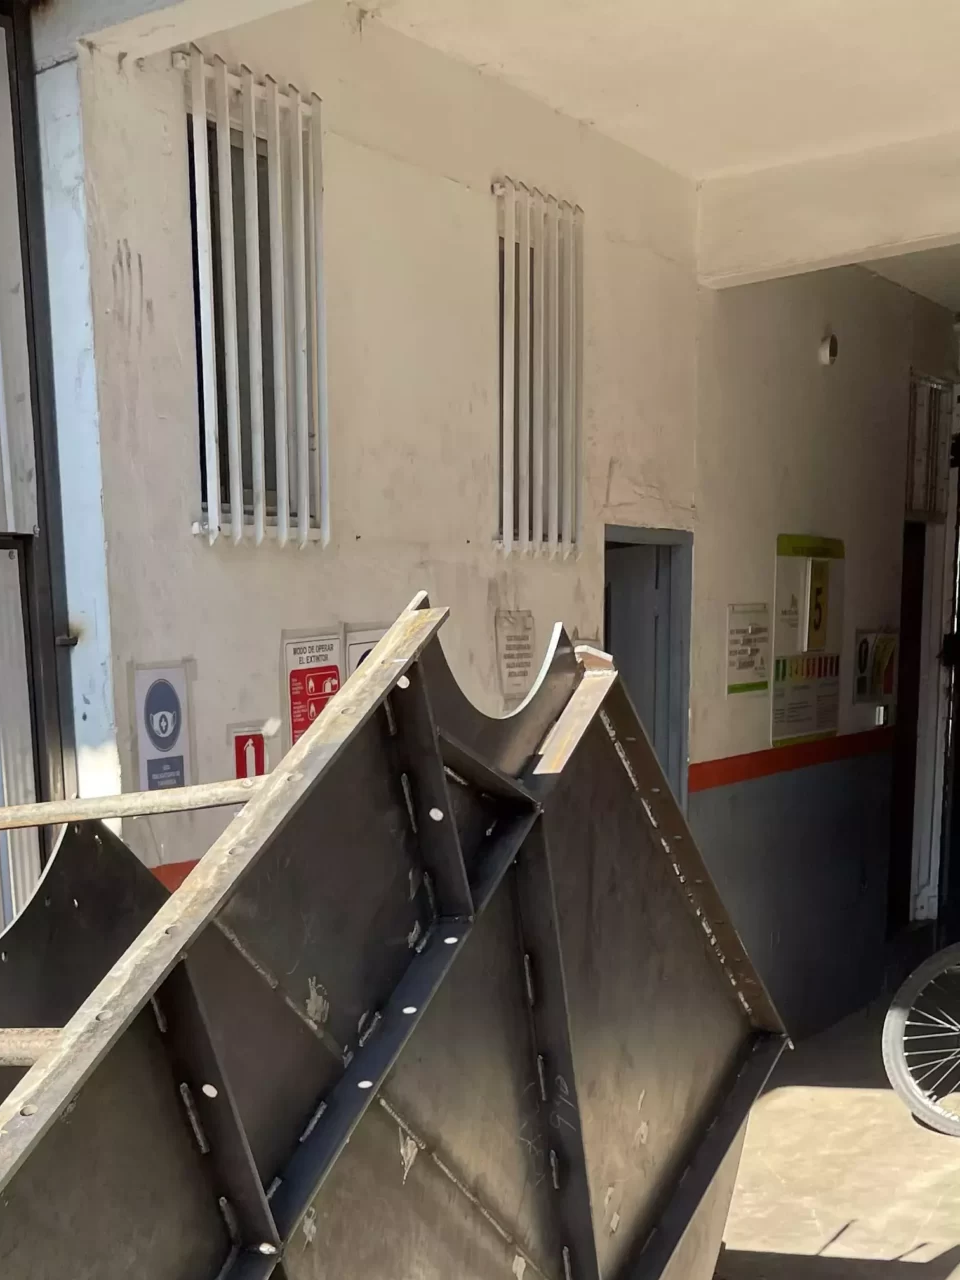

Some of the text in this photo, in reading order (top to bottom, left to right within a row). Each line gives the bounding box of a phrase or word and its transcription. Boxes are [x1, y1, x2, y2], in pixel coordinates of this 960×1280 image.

[292, 643, 334, 655] MODO DE OPERAR
[299, 654, 328, 665] EL EXTINTOR
